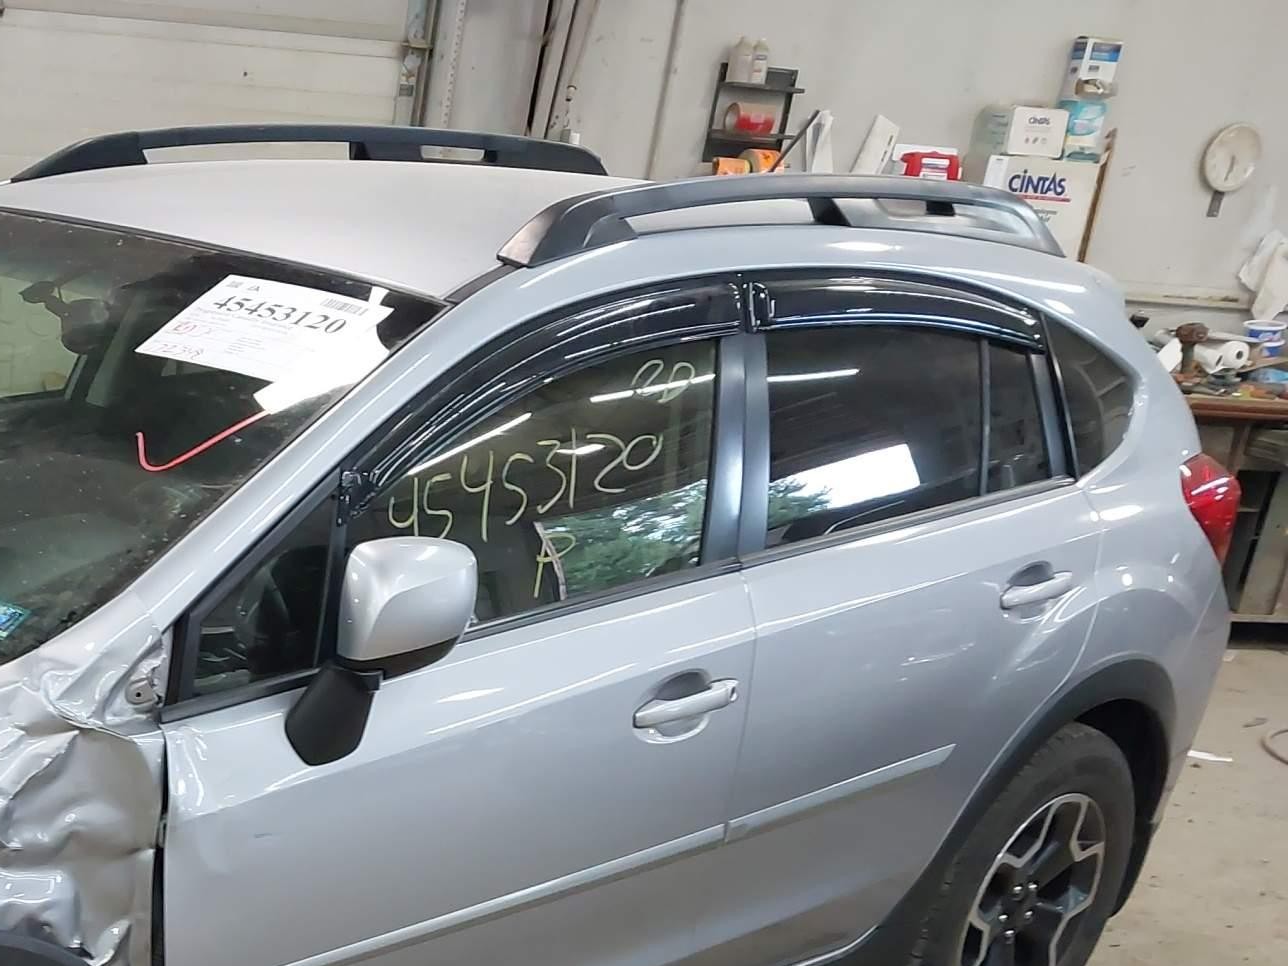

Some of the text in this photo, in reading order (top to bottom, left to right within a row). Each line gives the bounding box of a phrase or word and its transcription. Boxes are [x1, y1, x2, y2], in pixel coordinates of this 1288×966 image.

[1008, 169, 1066, 196] CINTAS
[213, 295, 347, 334] 45453120
[387, 428, 663, 544] 45453120
